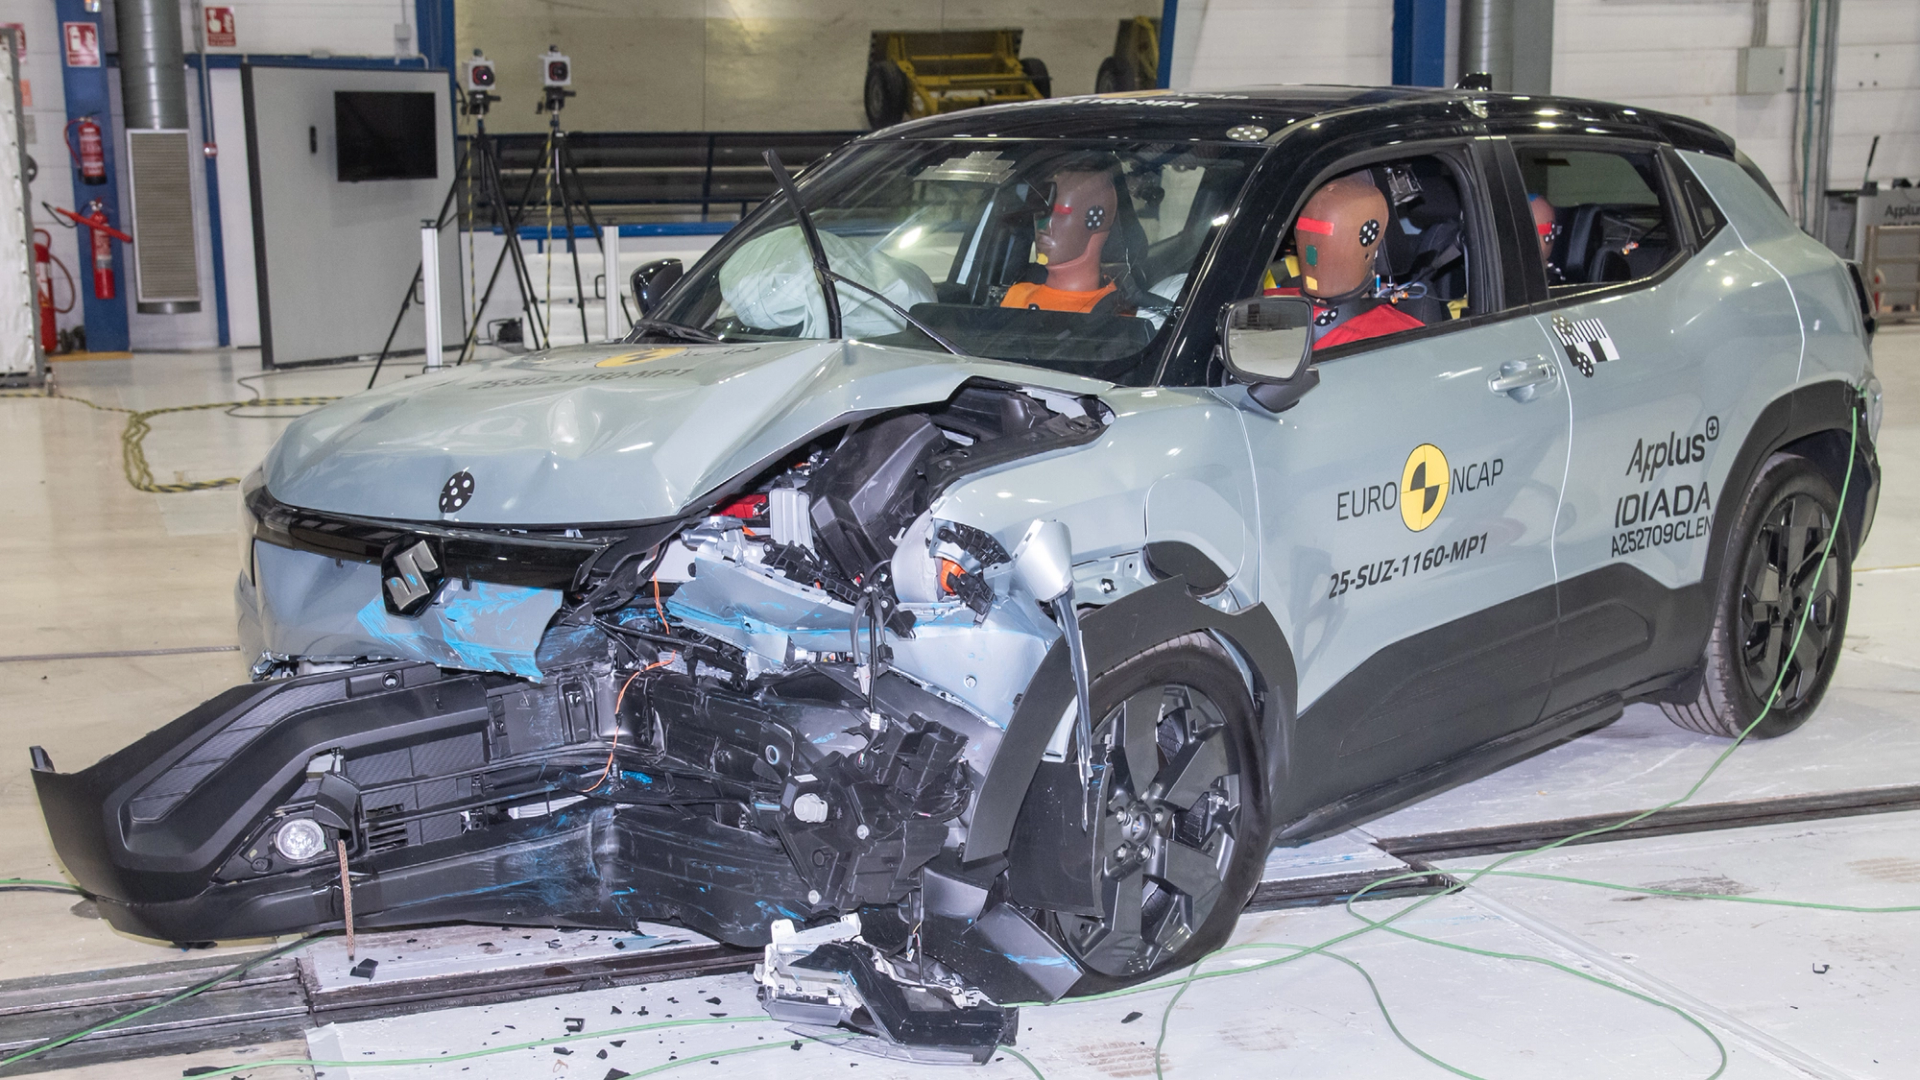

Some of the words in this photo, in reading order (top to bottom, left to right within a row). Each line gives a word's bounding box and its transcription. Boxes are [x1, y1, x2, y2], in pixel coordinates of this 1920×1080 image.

[467, 367, 695, 390] 25-SUZ-1160-MP1
[1337, 481, 1398, 522] EURO
[1451, 458, 1505, 495] NCAP
[1615, 481, 1711, 529] IDIADA
[1328, 532, 1489, 600] 25-SUZ-1160-MP1
